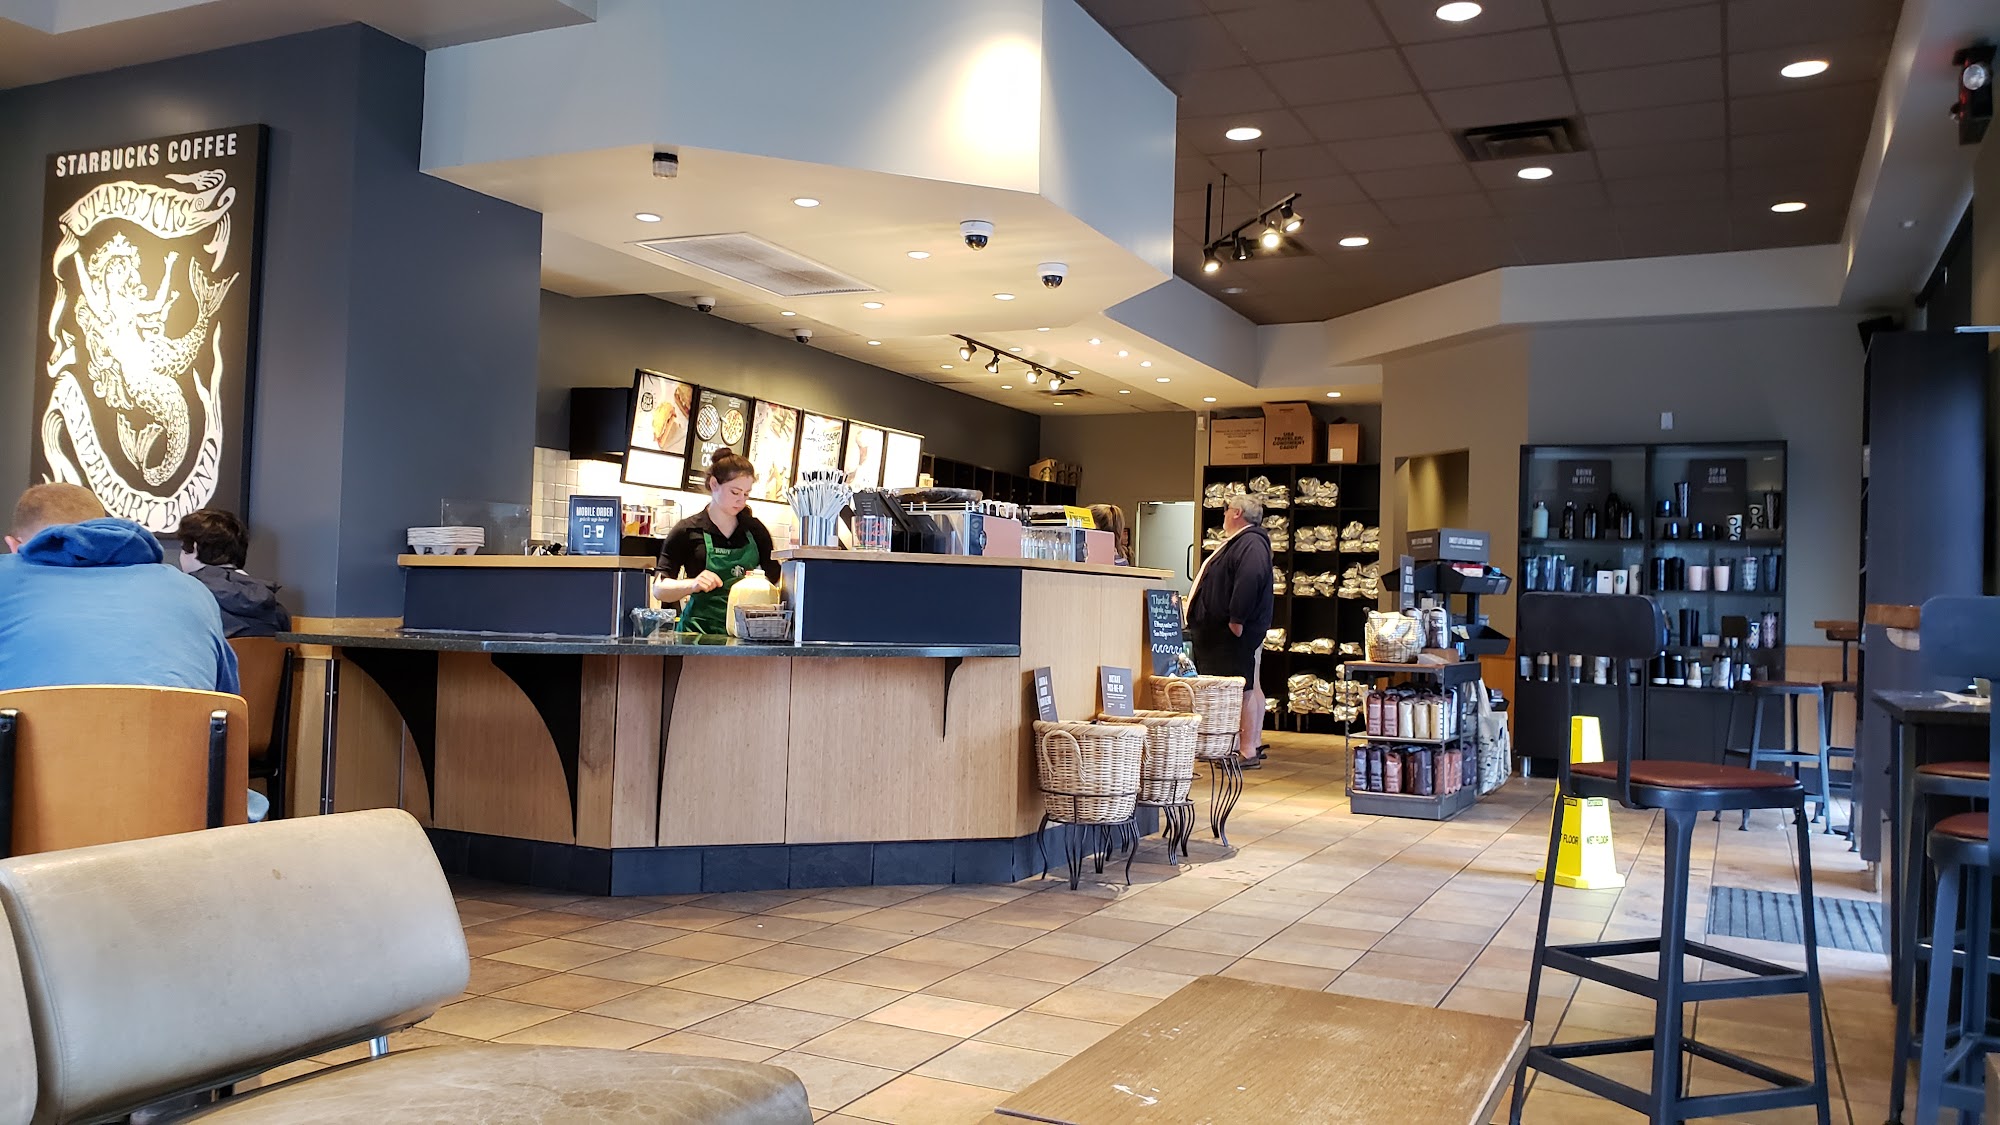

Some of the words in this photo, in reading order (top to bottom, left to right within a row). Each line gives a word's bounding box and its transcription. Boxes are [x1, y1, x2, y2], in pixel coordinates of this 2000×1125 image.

[56, 143, 159, 177] STARBUCKS
[167, 133, 237, 163] COFFEE
[1575, 468, 1592, 476] DRINK
[1708, 467, 1719, 475] SIP
[163, 437, 218, 528] BLEND
[1572, 476, 1579, 484] IN
[1579, 476, 1595, 485] STYLE
[1708, 475, 1727, 484] COLOR
[576, 506, 596, 517] MOBILE
[596, 507, 614, 517] ORDER
[1563, 834, 1579, 845] FLOOR
